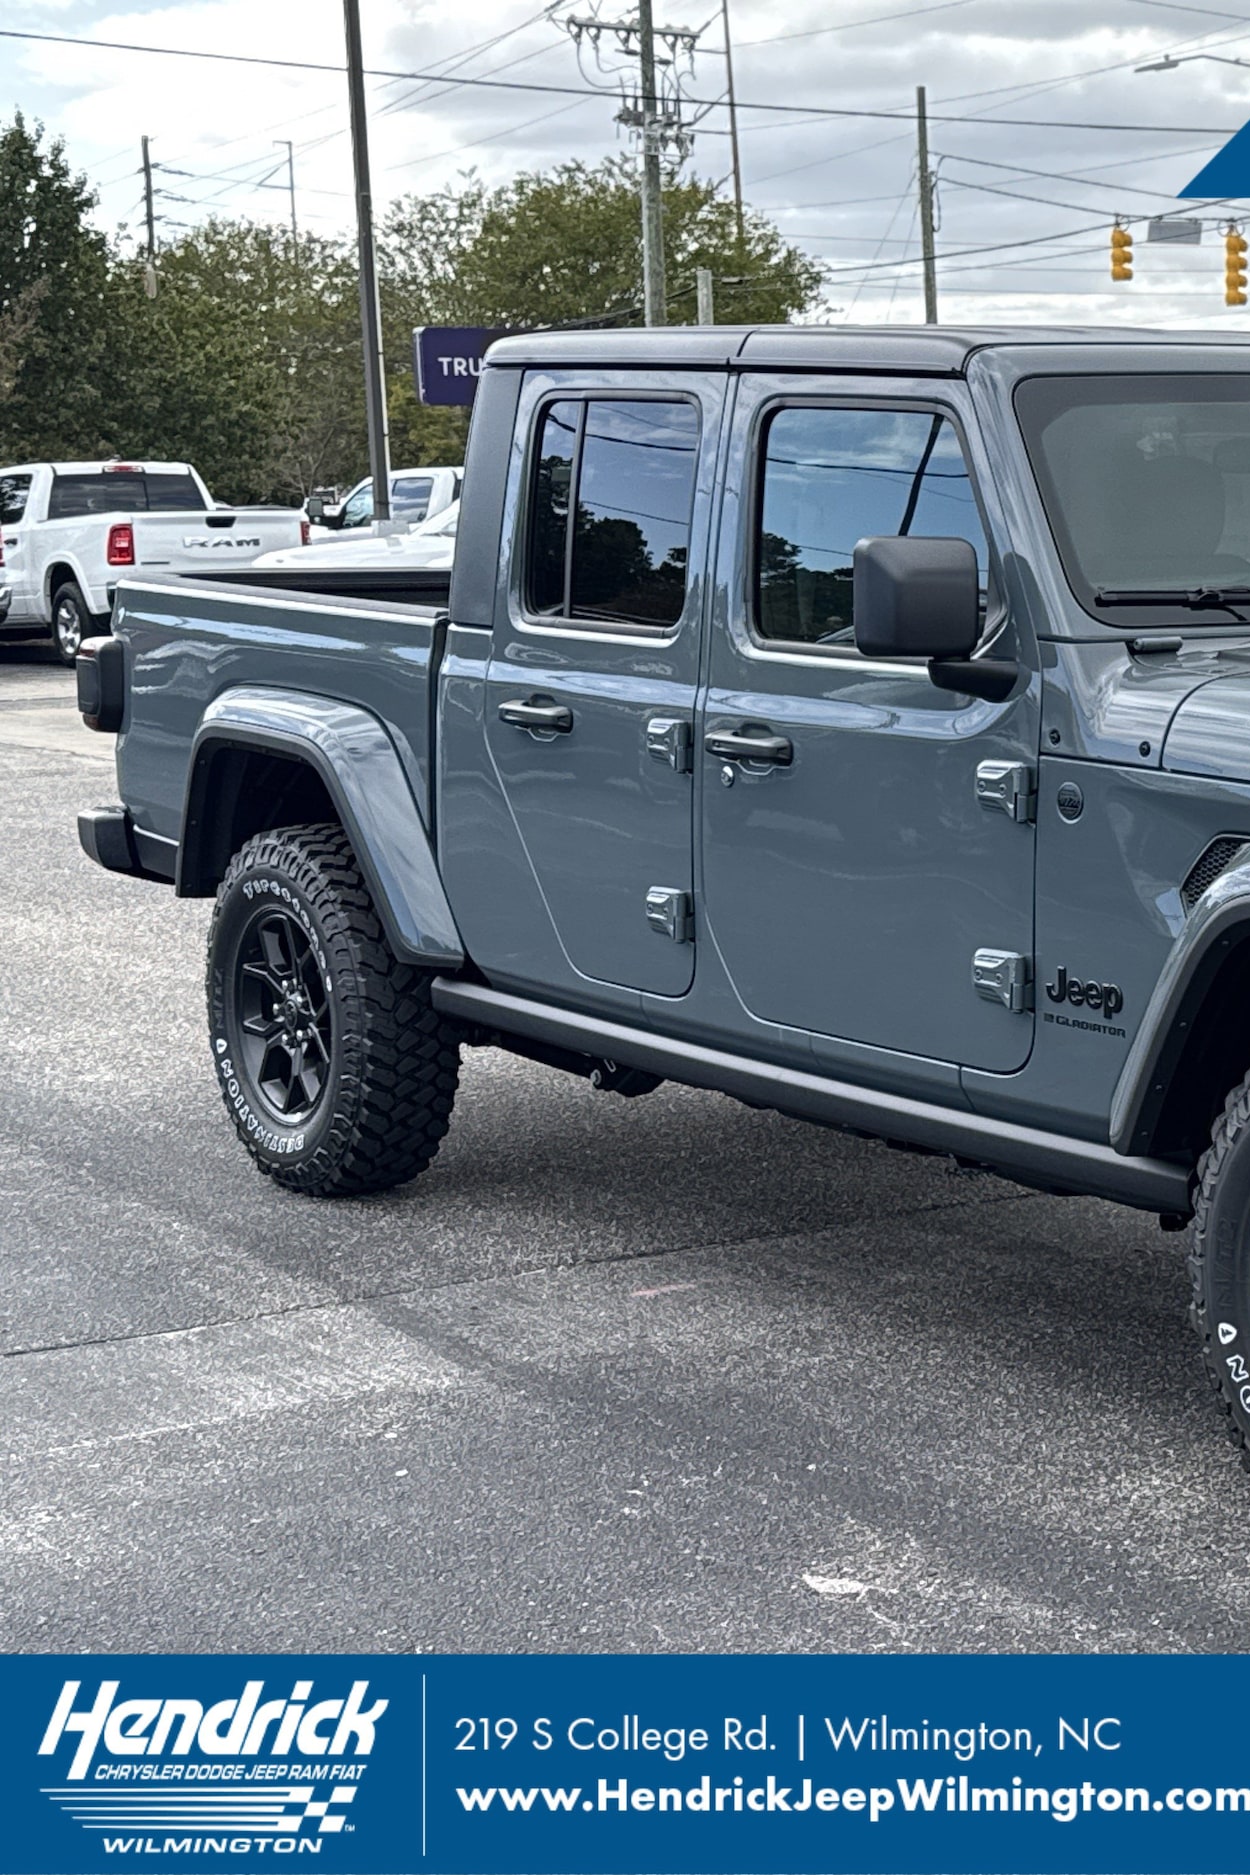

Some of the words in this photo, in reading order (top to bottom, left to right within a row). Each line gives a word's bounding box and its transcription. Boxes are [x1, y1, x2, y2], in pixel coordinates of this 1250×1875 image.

[183, 536, 261, 548] RAM
[1045, 965, 1124, 1020] Jeep
[1055, 1015, 1126, 1039] GLADIATOR
